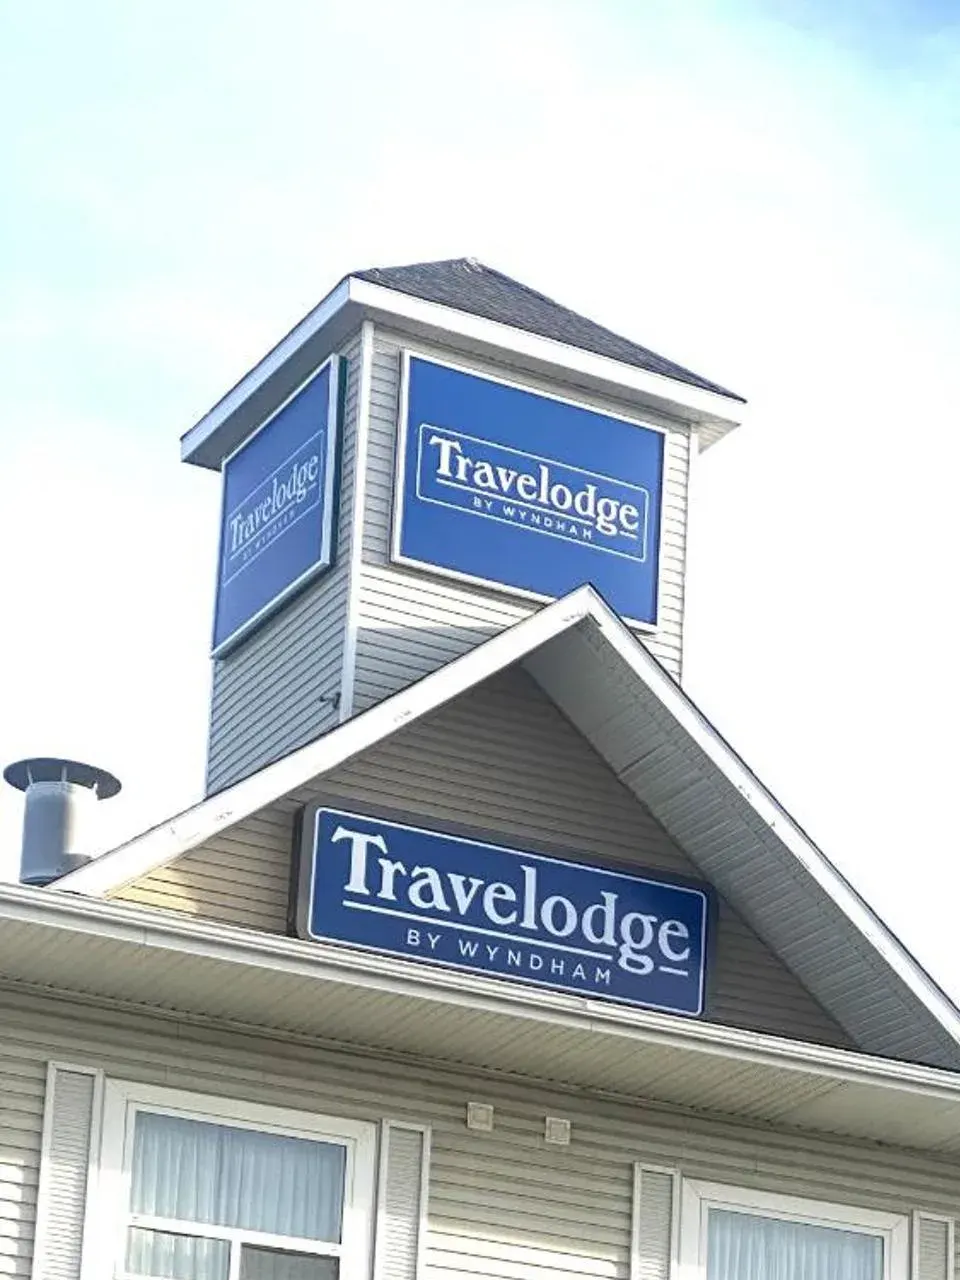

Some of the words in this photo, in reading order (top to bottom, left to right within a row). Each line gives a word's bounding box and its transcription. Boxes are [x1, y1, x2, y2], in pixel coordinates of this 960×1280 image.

[229, 455, 319, 553] Travelodge
[429, 434, 640, 536] Travelodge
[472, 495, 493, 510] BY
[502, 504, 593, 541] WYNDHAM
[330, 825, 691, 975] Travelodge
[406, 929, 442, 950] BY
[458, 939, 612, 985] WYNDHAM
